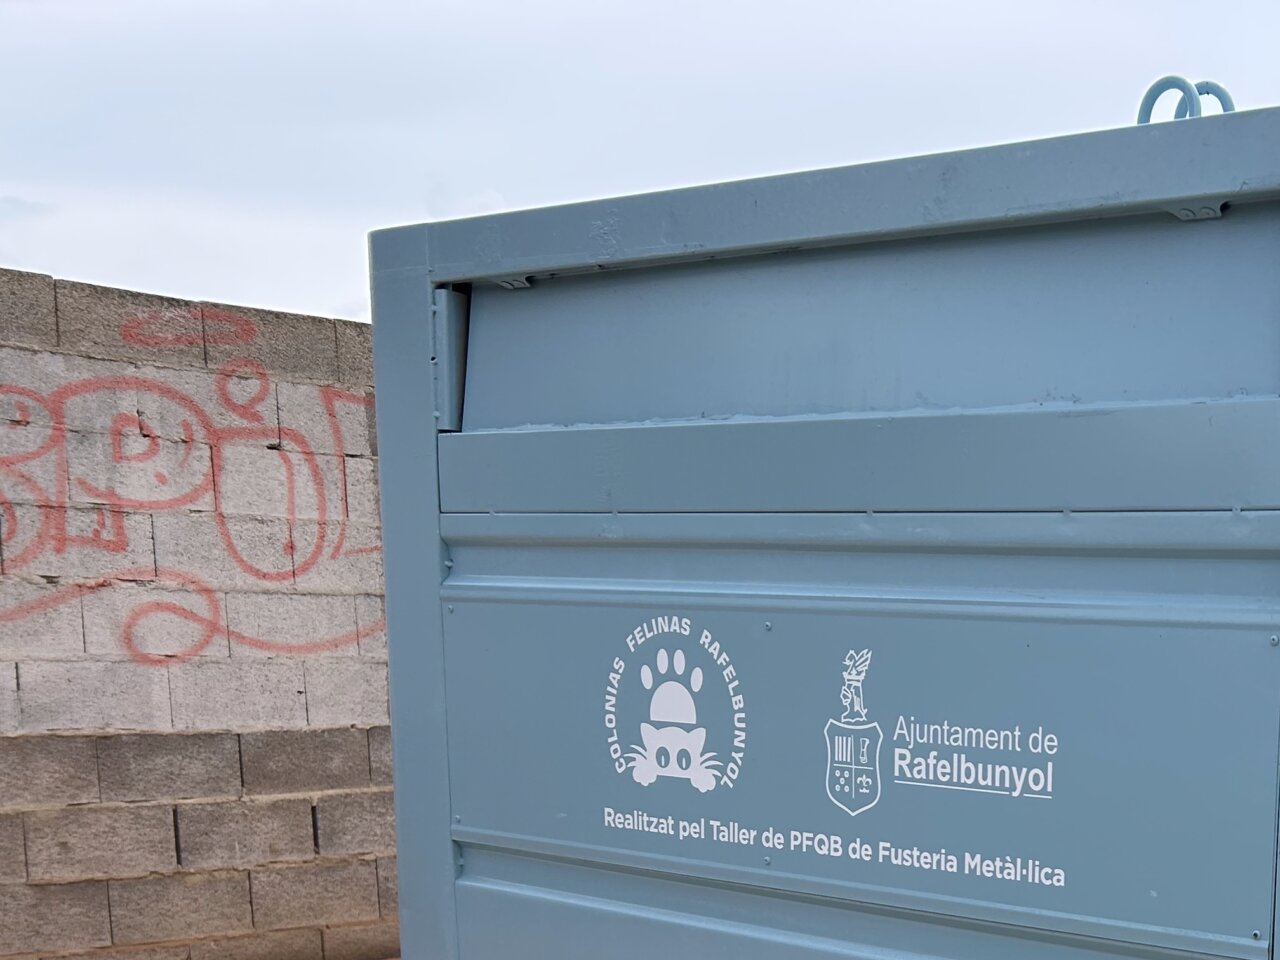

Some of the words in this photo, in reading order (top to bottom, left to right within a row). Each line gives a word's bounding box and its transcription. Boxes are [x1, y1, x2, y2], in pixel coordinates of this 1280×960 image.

[604, 656, 626, 774] COLONIAS
[625, 615, 691, 653] FELINAS
[699, 629, 746, 789] RAFELBUNYOL
[894, 715, 1021, 752] Ajuntament
[1029, 727, 1058, 755] de
[894, 748, 1054, 797] Rafelbunyol
[604, 807, 675, 835] Realitzat
[679, 818, 705, 840] pel
[709, 820, 757, 846] Taller
[761, 827, 785, 850] de
[790, 830, 843, 858] PFQB
[848, 838, 873, 861] de
[878, 841, 958, 873] Fusteria
